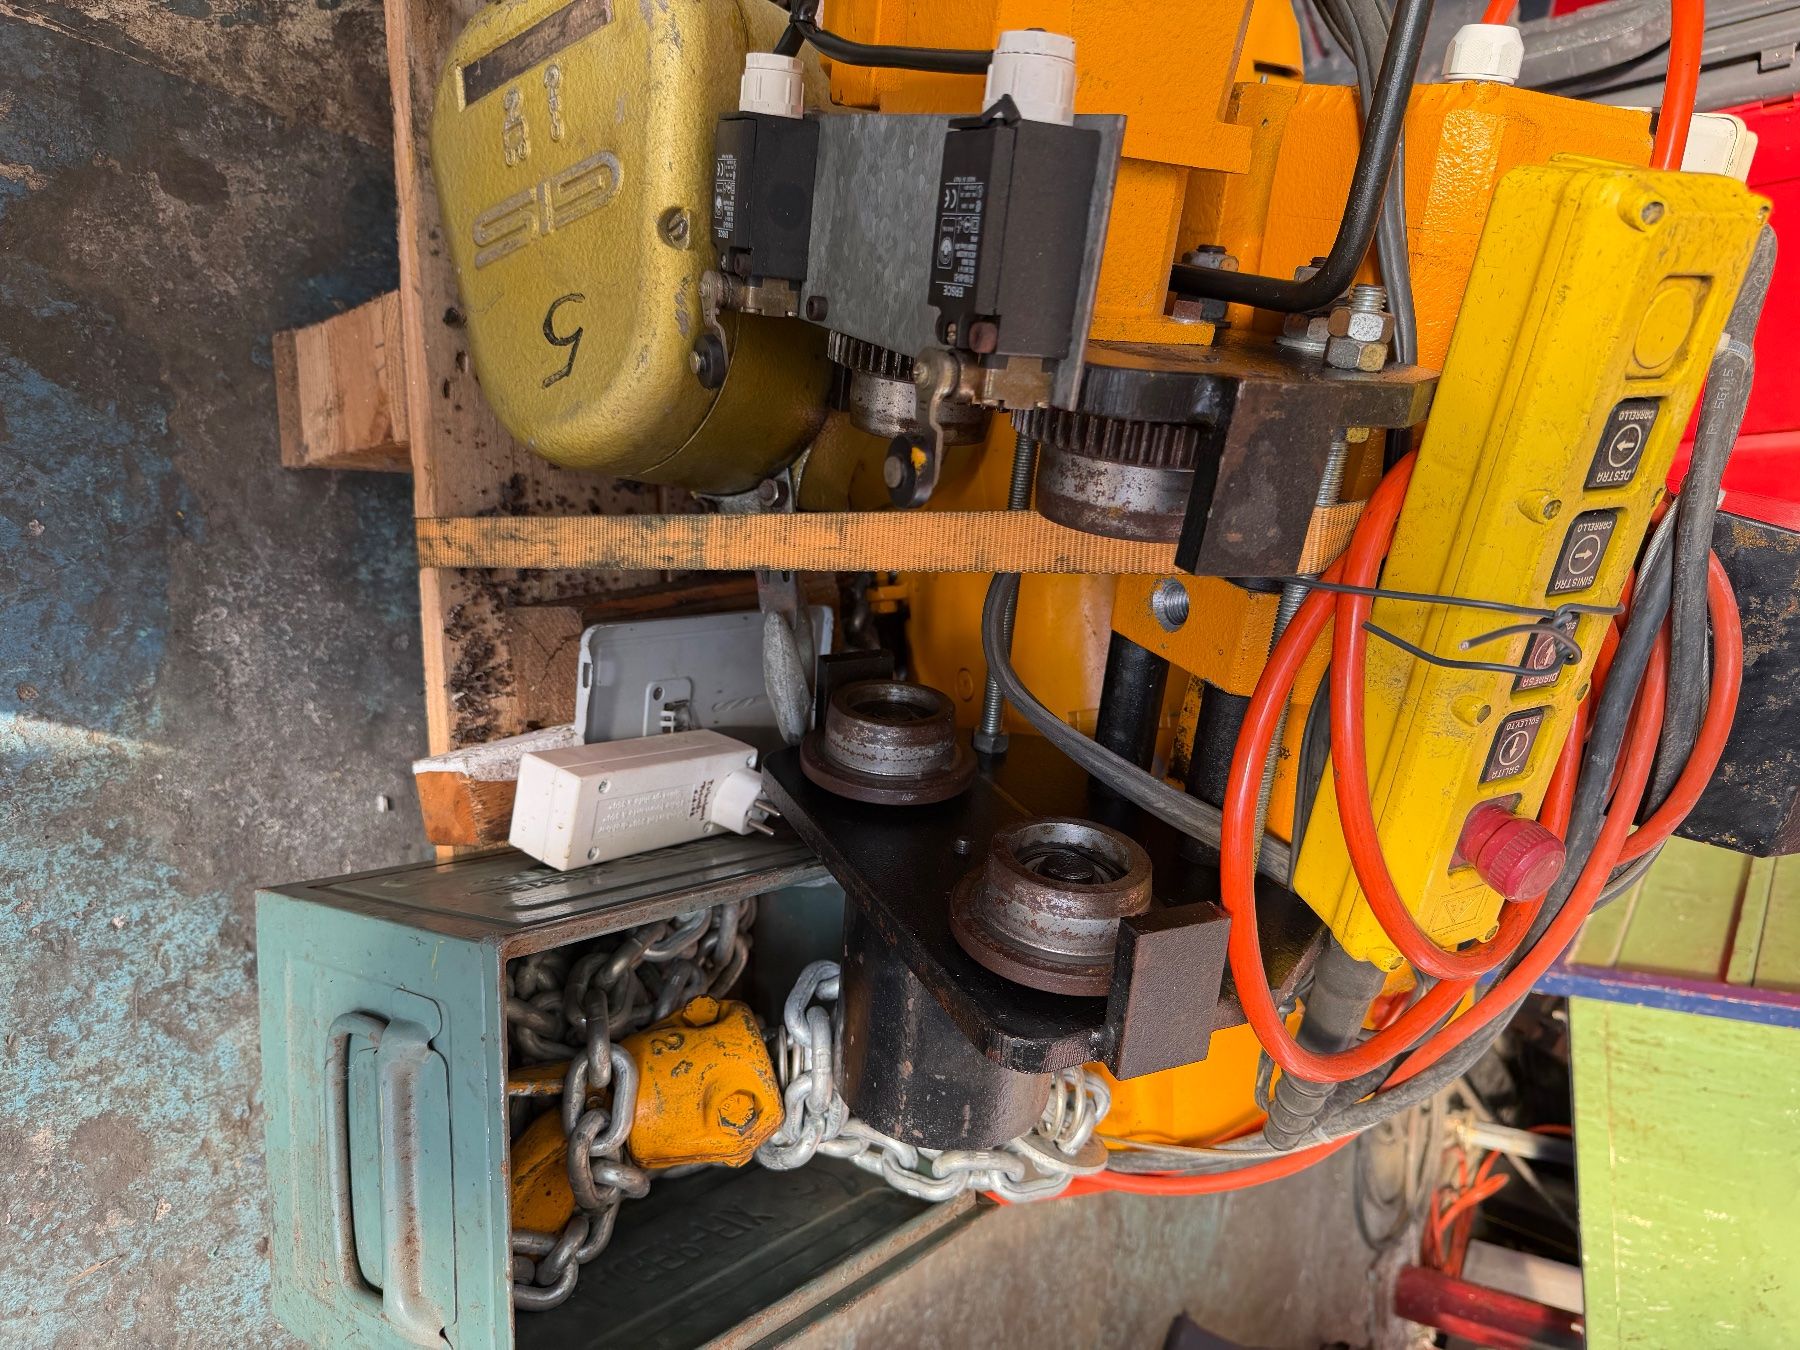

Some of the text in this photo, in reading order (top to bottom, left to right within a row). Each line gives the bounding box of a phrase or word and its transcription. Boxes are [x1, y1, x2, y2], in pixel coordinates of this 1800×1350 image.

[472, 151, 624, 270] GIS
[541, 292, 586, 389] 5
[1618, 409, 1655, 421] CARRELLO
[1596, 469, 1632, 483] DESTRA
[1577, 521, 1613, 532] CARRELLO
[1554, 576, 1594, 590] SINISTRA
[1491, 765, 1520, 779] SALITA
